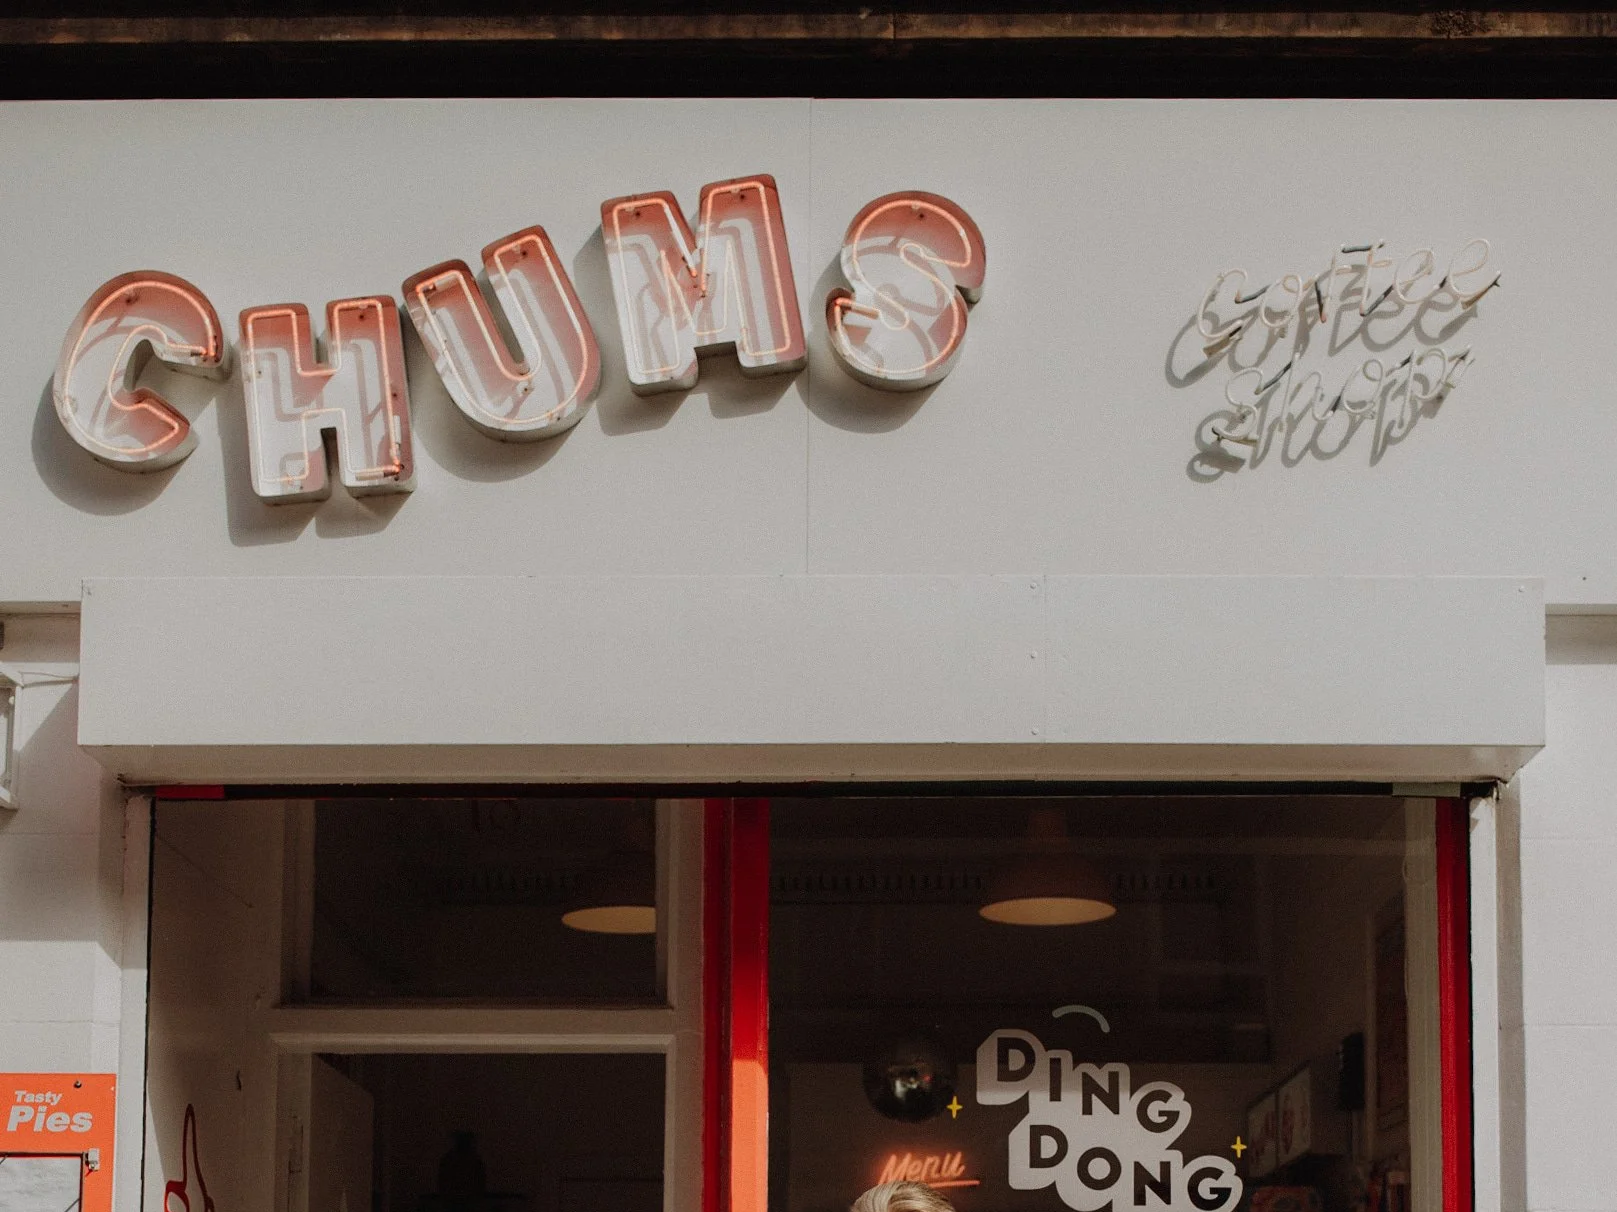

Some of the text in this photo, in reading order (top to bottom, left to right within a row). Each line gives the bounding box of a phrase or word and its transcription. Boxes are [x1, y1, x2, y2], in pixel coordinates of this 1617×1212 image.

[55, 174, 986, 505] CHUMS
[15, 1090, 62, 1106] Tasty
[995, 1035, 1181, 1134] DING
[7, 1105, 93, 1132] Pies
[879, 1151, 966, 1185] Menu
[1028, 1124, 1233, 1212] DONG
